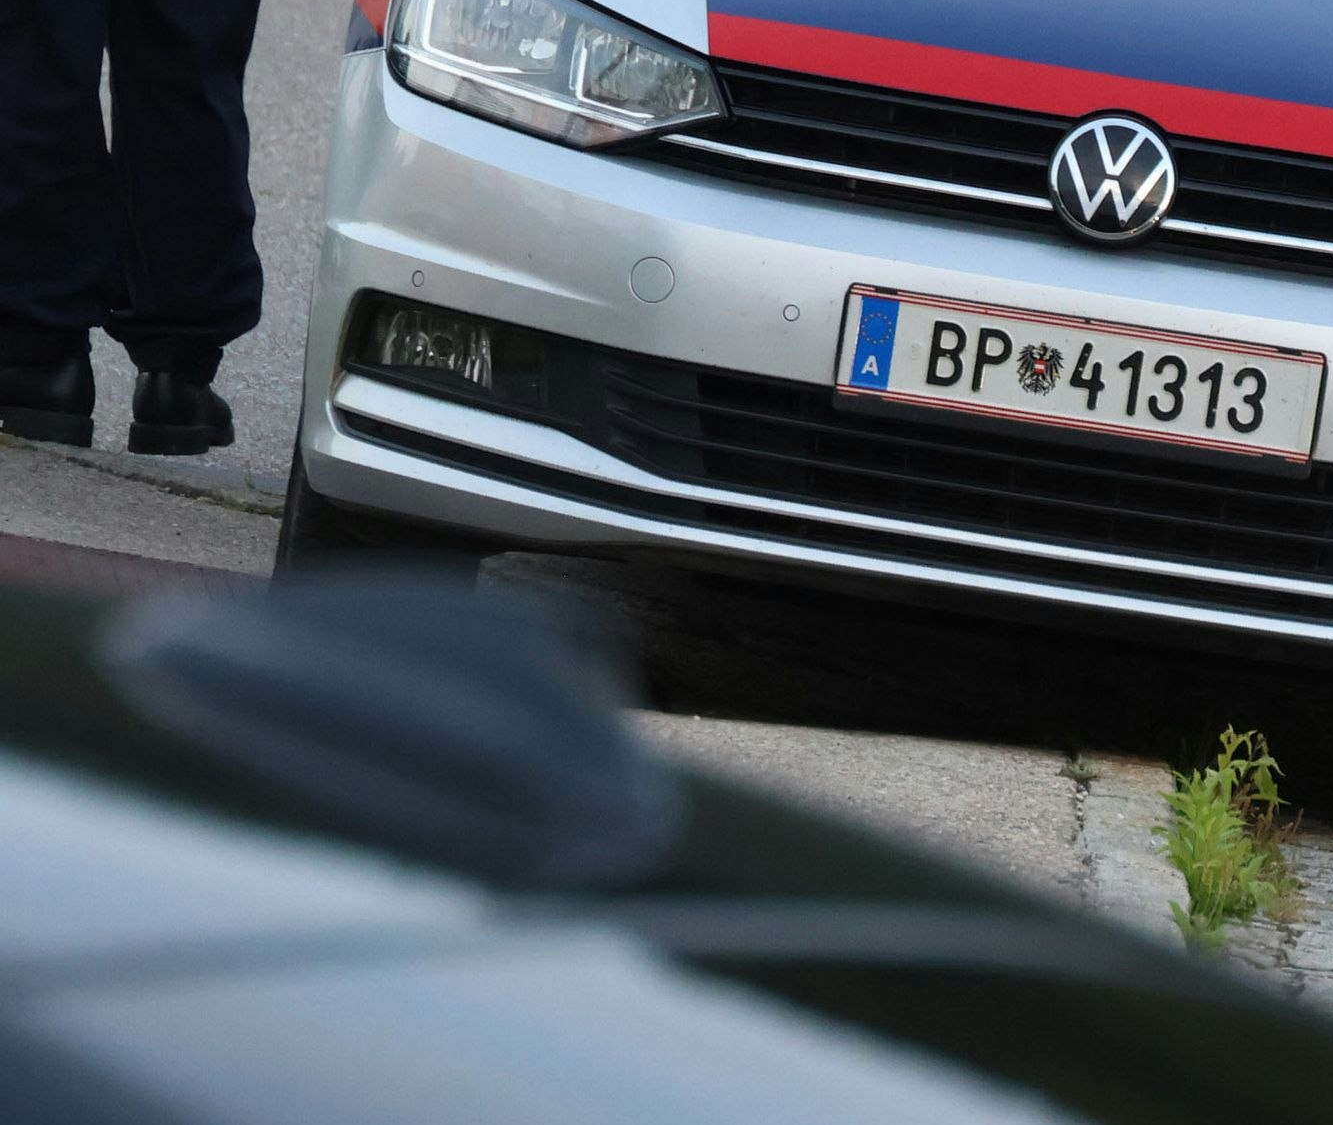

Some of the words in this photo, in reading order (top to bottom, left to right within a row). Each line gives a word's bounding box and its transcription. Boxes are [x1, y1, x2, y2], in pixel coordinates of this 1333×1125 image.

[1050, 118, 1175, 239] VW
[861, 354, 879, 376] A
[925, 320, 1013, 393] BP
[1069, 342, 1268, 434] 41313
